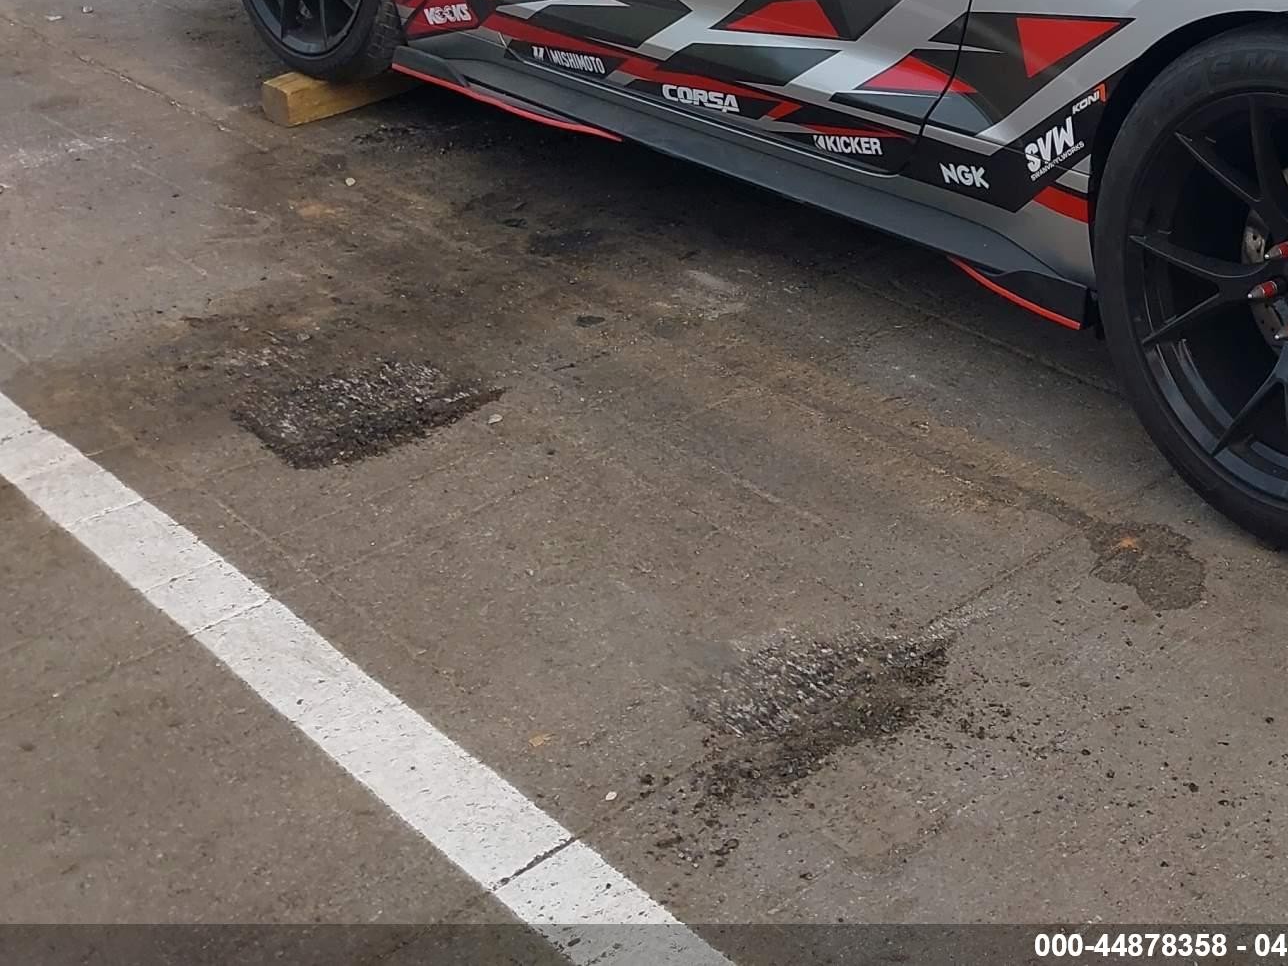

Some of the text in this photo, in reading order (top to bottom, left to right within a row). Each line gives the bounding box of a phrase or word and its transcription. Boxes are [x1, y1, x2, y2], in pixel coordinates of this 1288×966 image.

[423, 3, 472, 25] KOOKS
[550, 49, 605, 74] MISHIMOTO
[662, 84, 740, 113] CORSA
[1072, 90, 1100, 114] KONI
[825, 135, 883, 155] KICKER
[1025, 116, 1074, 172] SVW
[939, 162, 990, 189] NGK
